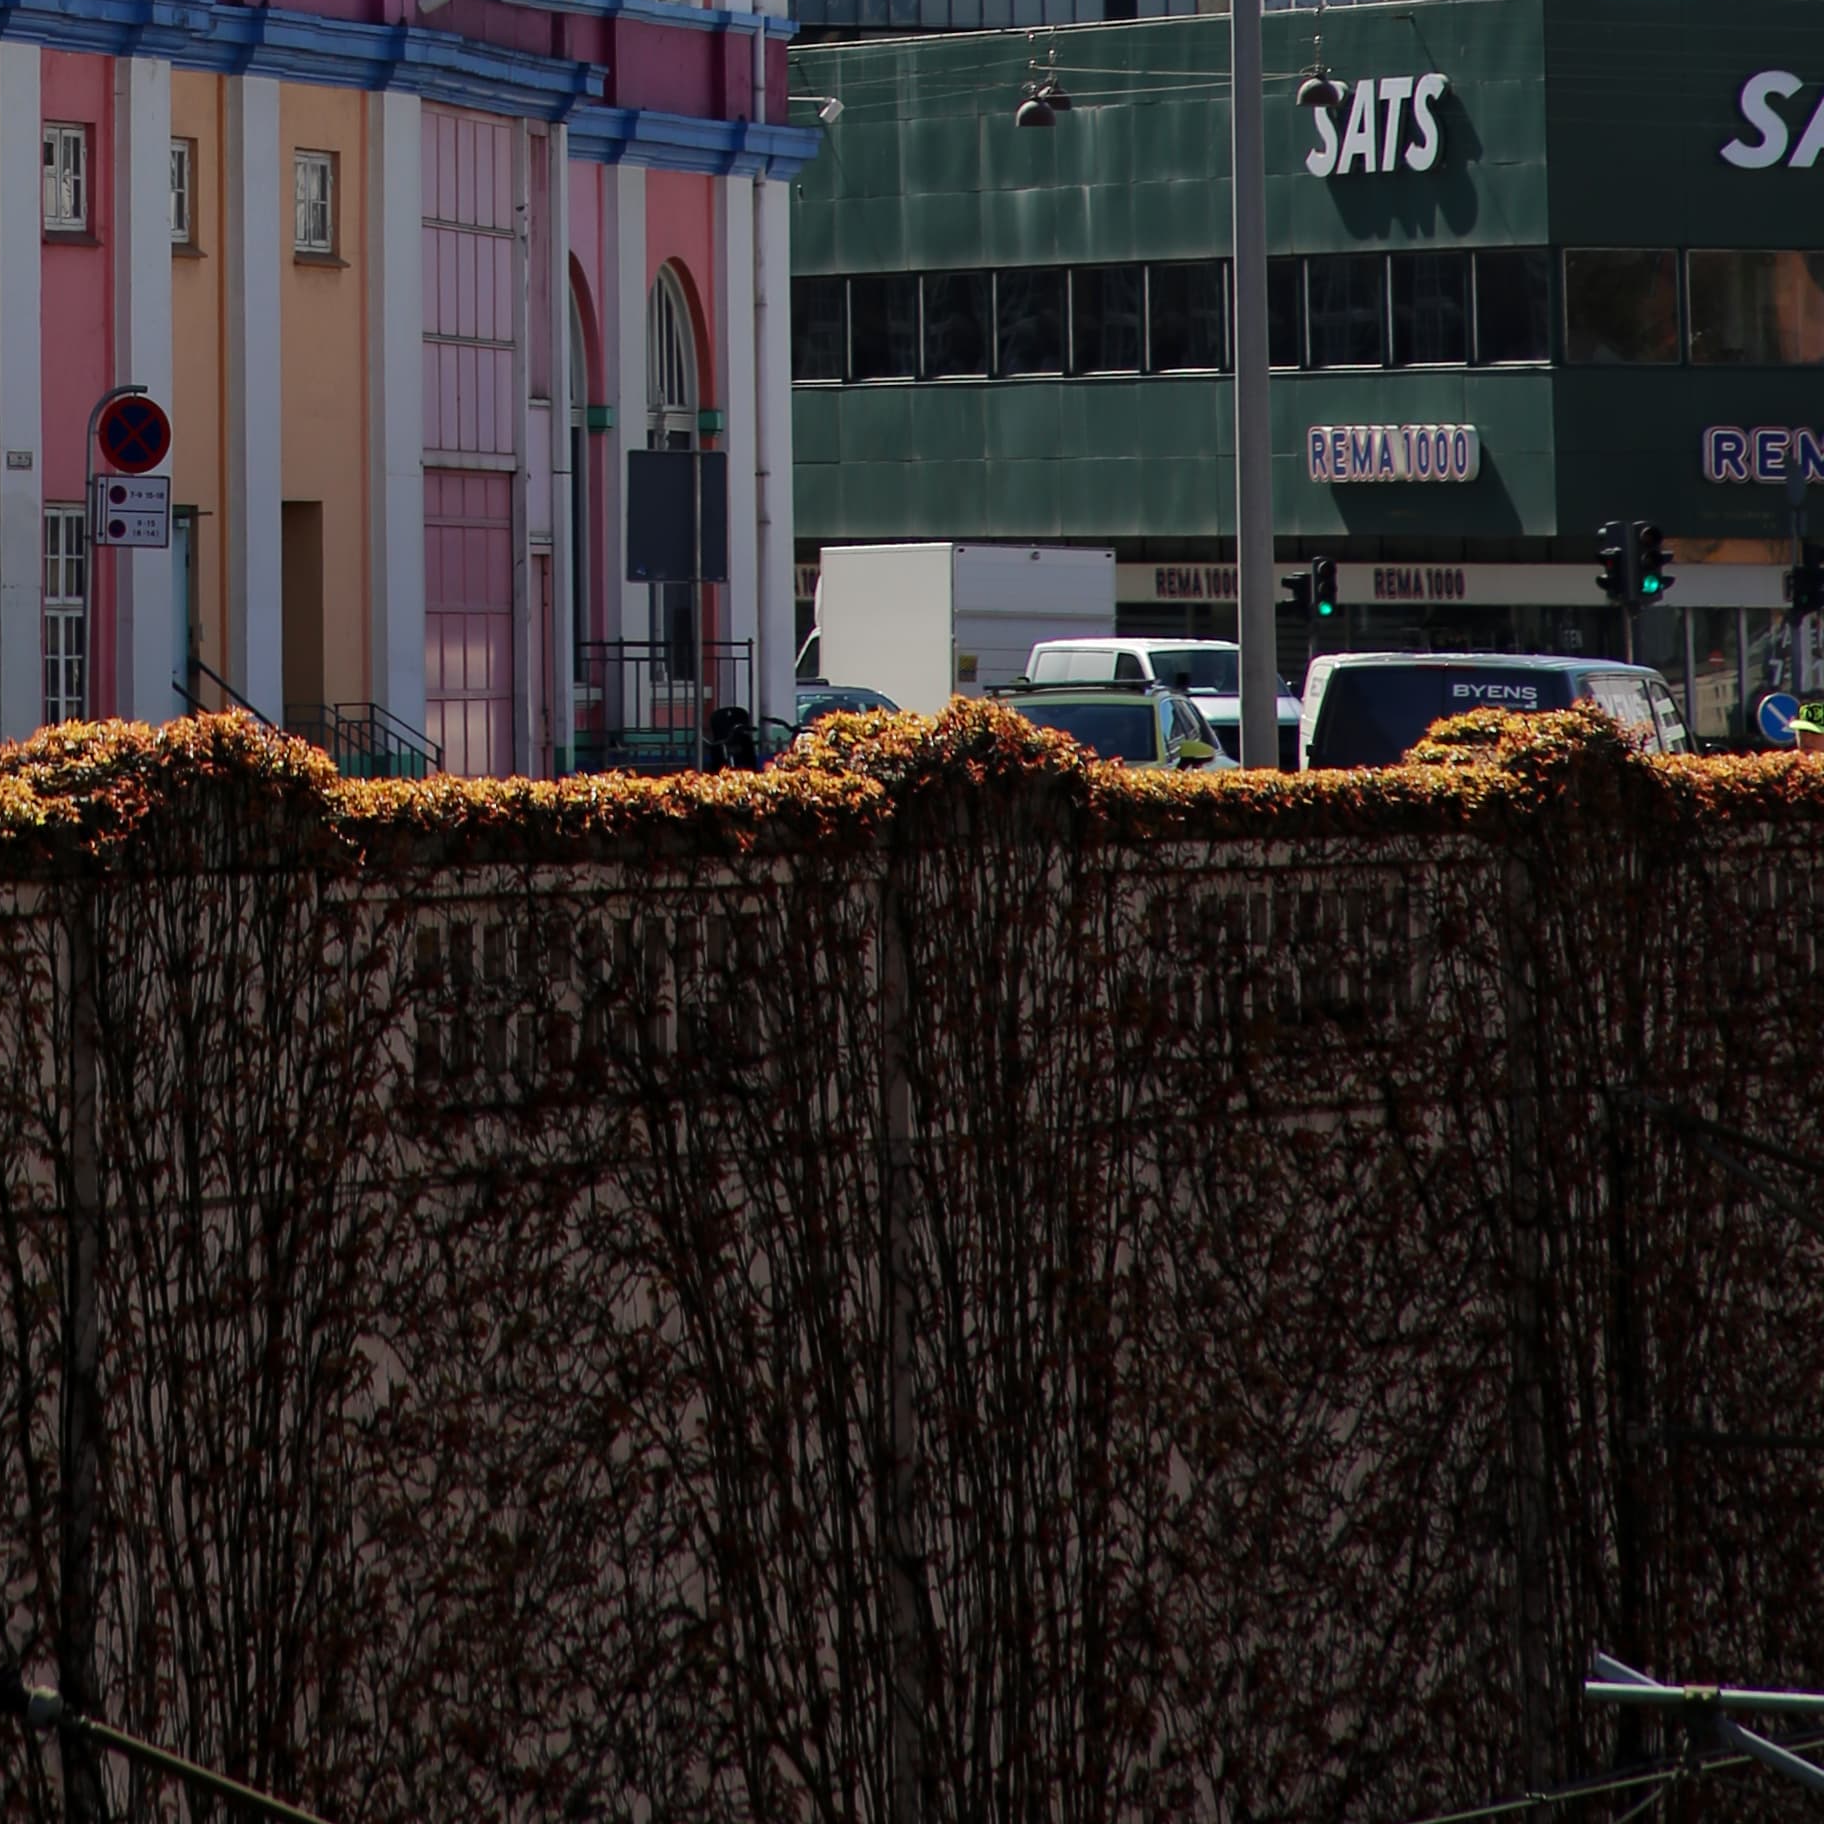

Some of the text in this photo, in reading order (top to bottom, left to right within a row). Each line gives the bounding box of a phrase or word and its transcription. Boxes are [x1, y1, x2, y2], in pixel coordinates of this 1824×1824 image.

[1305, 72, 1449, 177] SATS
[1310, 427, 1470, 480] REMA 1000
[1155, 567, 1204, 599] REMA
[1374, 567, 1465, 600] REMA 1000
[1452, 683, 1538, 700] BYENS
